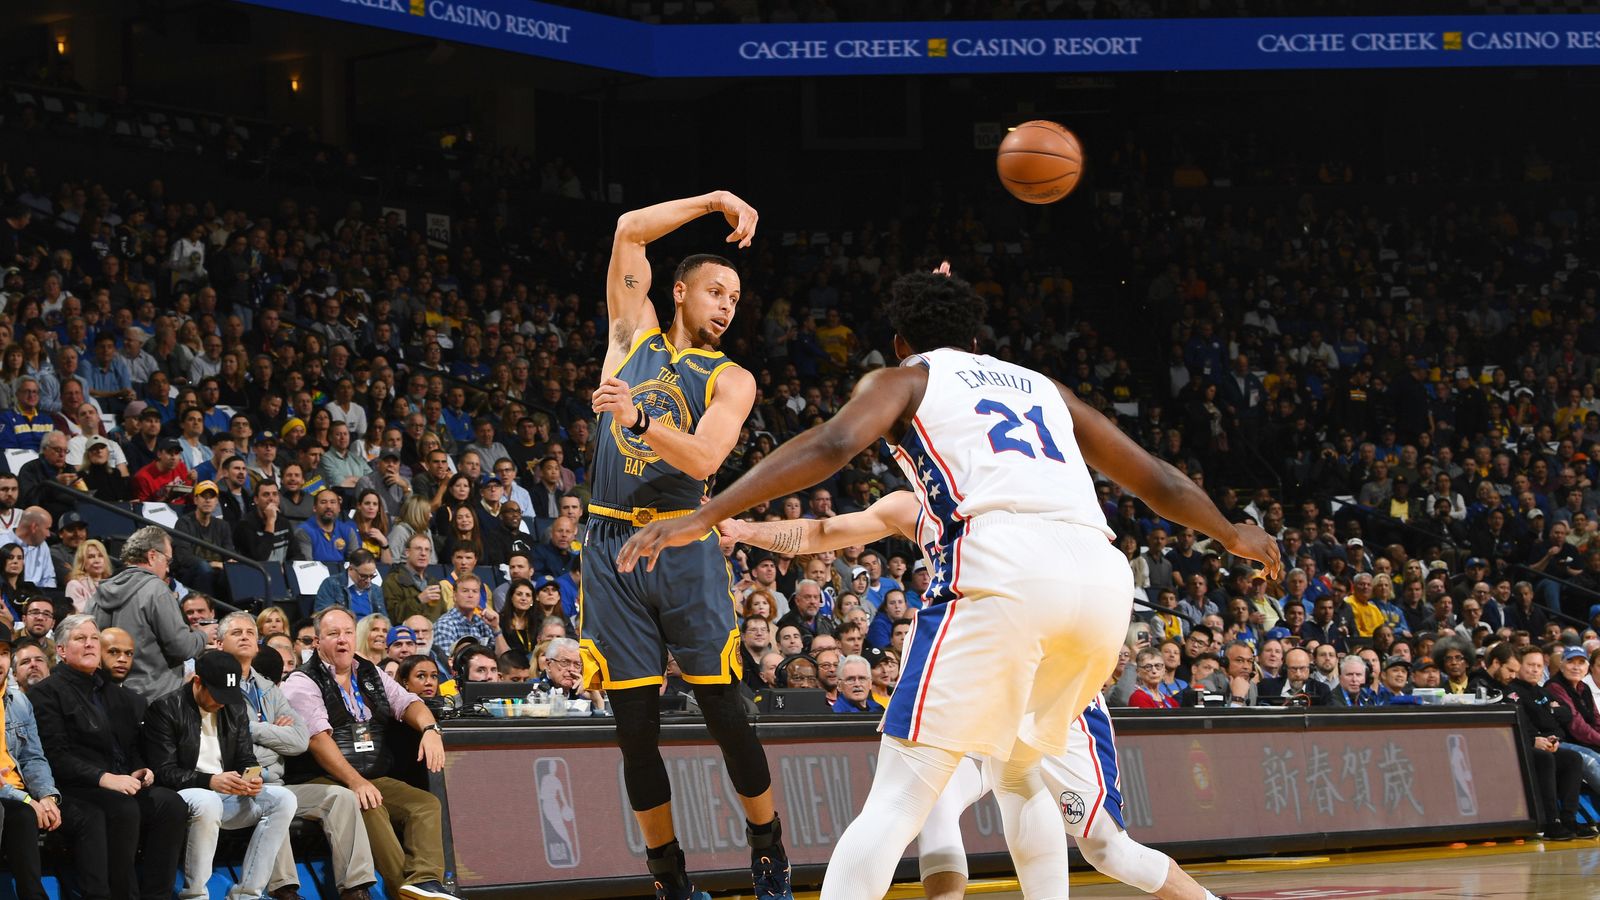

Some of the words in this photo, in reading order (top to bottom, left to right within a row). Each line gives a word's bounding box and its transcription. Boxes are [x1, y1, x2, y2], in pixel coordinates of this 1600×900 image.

[428, 1, 501, 31] CASINO
[504, 14, 572, 44] RESORT
[739, 40, 828, 59] CACHE
[834, 39, 921, 58] CREEK
[952, 38, 1046, 57] CASINO
[1054, 36, 1142, 56] RESORT
[1257, 34, 1346, 52] CACHE
[1351, 33, 1438, 51] CREEK
[1466, 31, 1559, 50] CASINO
[656, 366, 681, 385] THE
[684, 358, 711, 375] Rakuten
[955, 369, 1032, 394] EMBIID
[644, 392, 670, 410] 勇士
[974, 398, 1066, 464] 21
[624, 457, 647, 477] BAY
[226, 673, 236, 687] H
[617, 758, 748, 855] CINES
[780, 755, 854, 847] NEW
[1062, 802, 1083, 817] 76ers
